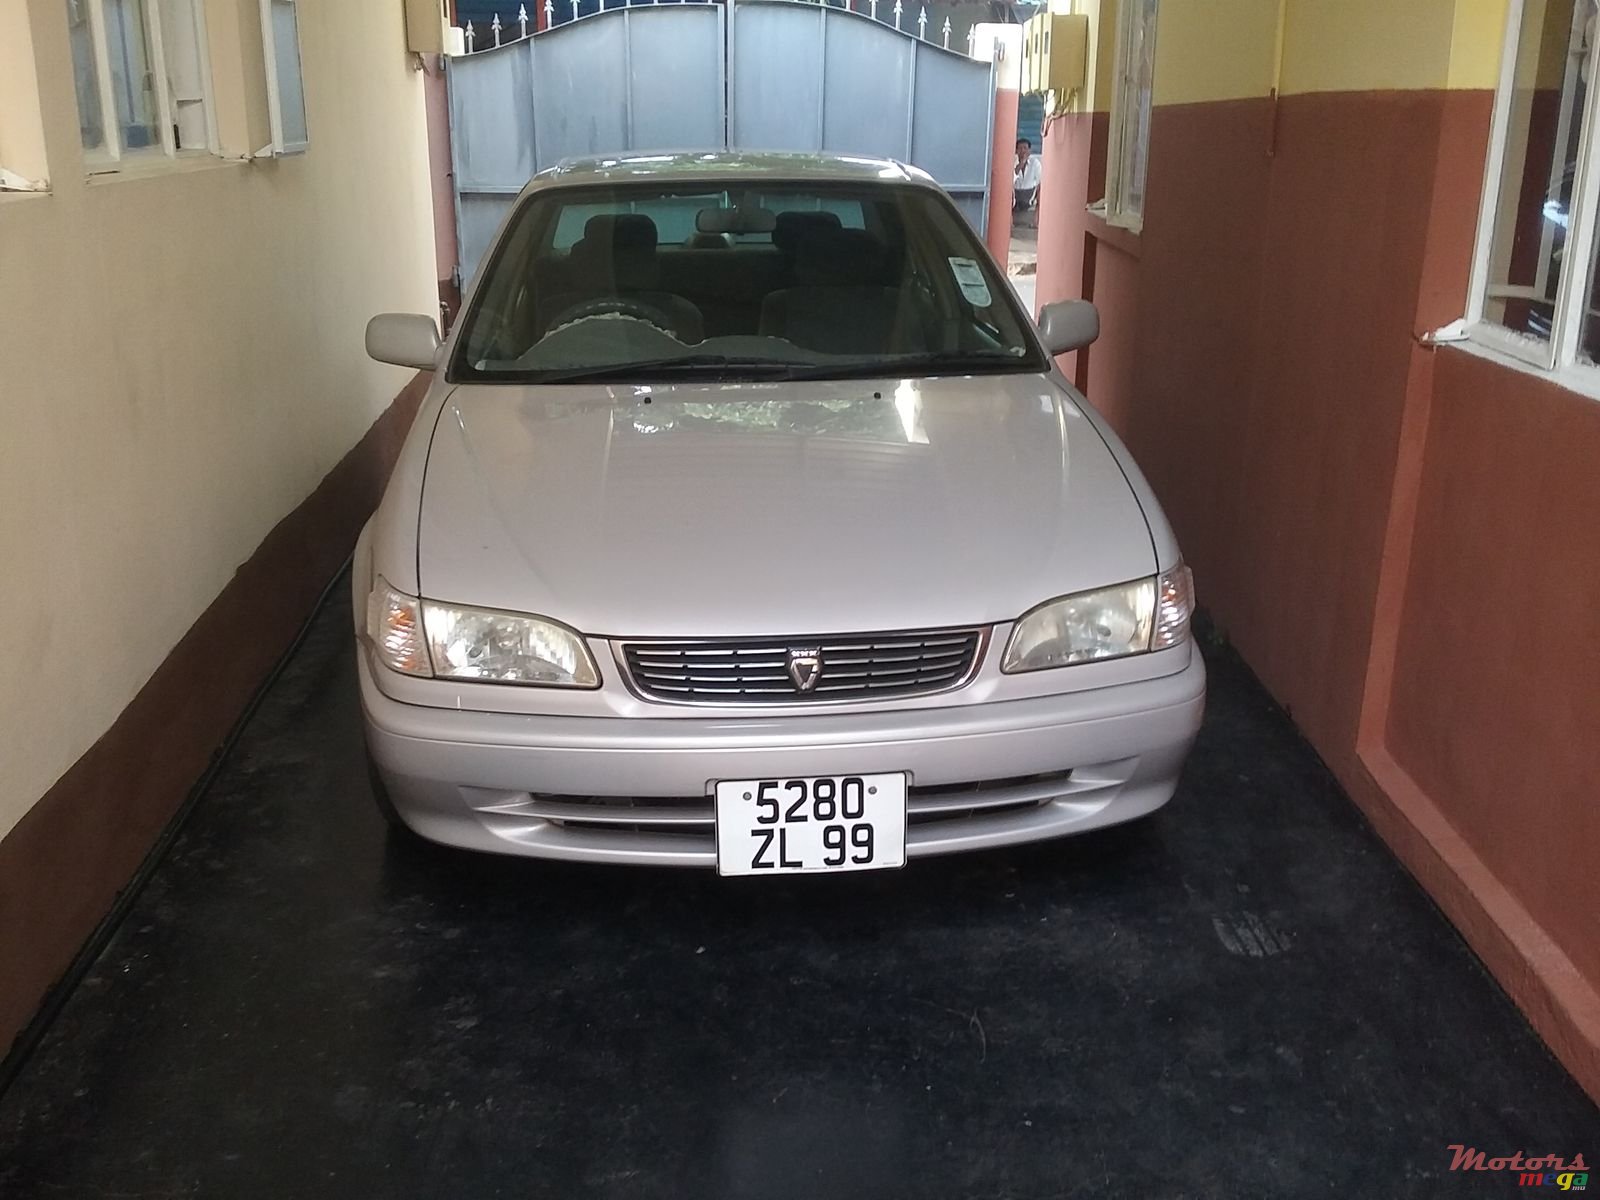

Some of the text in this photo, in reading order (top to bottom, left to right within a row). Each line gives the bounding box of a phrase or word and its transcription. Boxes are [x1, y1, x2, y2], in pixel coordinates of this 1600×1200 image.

[756, 777, 865, 825] 5280
[751, 823, 874, 869] ZL 99
